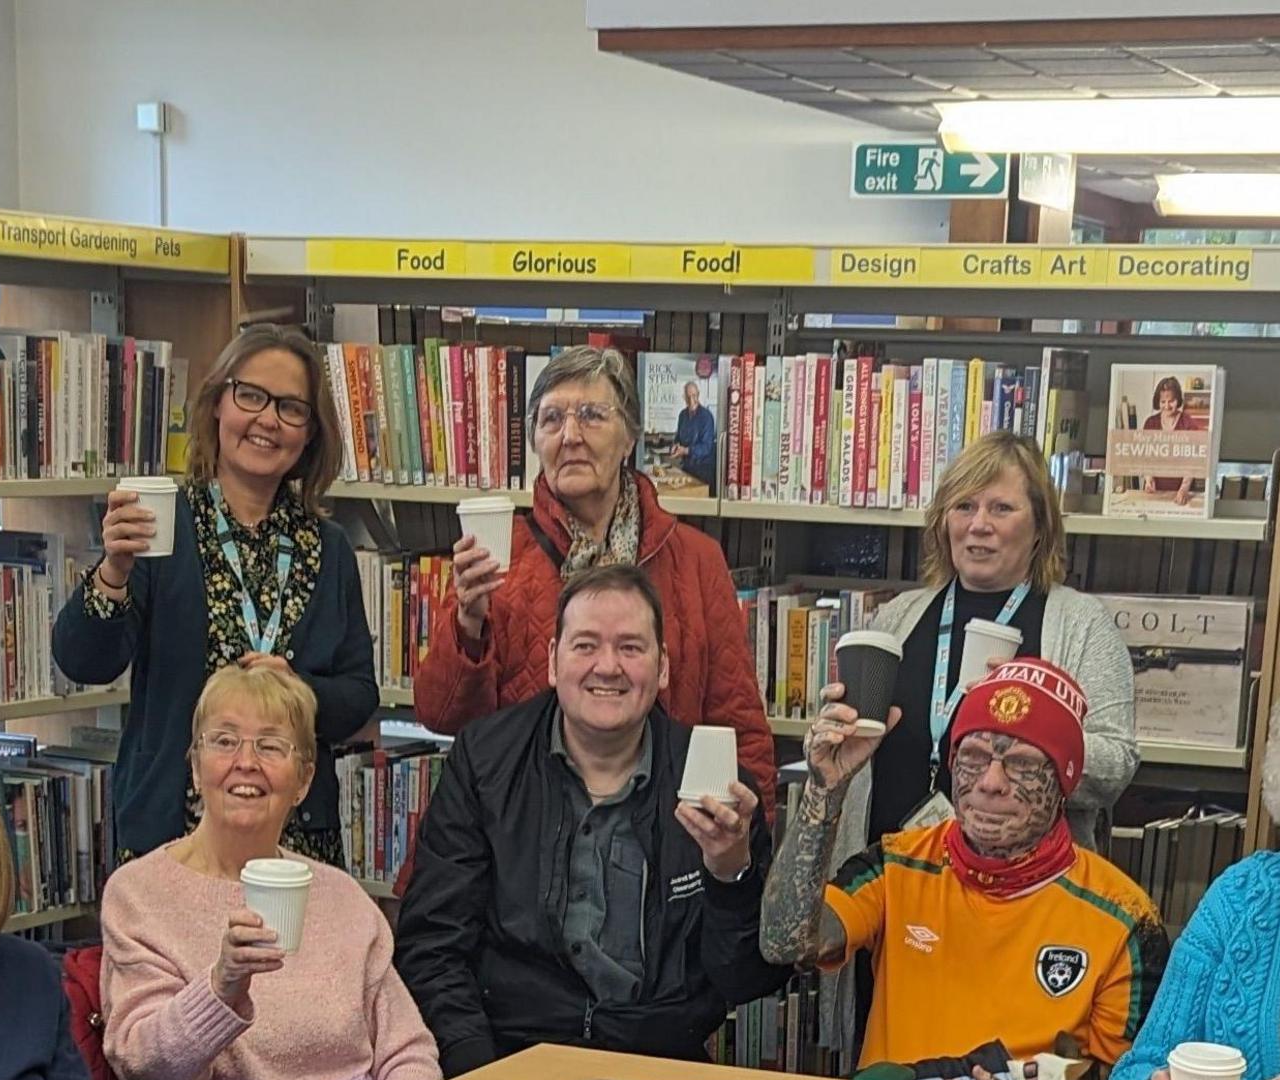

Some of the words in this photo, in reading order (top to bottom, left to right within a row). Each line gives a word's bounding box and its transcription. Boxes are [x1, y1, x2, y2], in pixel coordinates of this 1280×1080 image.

[865, 149, 900, 168] Fire
[865, 174, 899, 191] exit
[0, 220, 65, 249] Transport
[70, 227, 138, 257] Gardening
[155, 237, 181, 257] Pets
[397, 248, 445, 271] Food
[513, 251, 596, 274] Glorious
[683, 249, 741, 273] Food!
[841, 254, 917, 278] Design
[963, 254, 1033, 277] Crafts
[1050, 254, 1087, 277] Art
[1118, 255, 1250, 281] Decorating
[648, 362, 672, 375] RICK
[648, 373, 677, 384] STEIN
[845, 375, 853, 415] GREAT
[780, 433, 790, 485] BREAD
[842, 434, 851, 483] SALADS
[1115, 443, 1169, 457] SEWING
[1173, 444, 1207, 458] BIBLE
[1114, 610, 1217, 636] COLT
[996, 664, 1047, 686] MAN
[1054, 681, 1084, 716] UTD
[1047, 950, 1080, 966] Ireland
